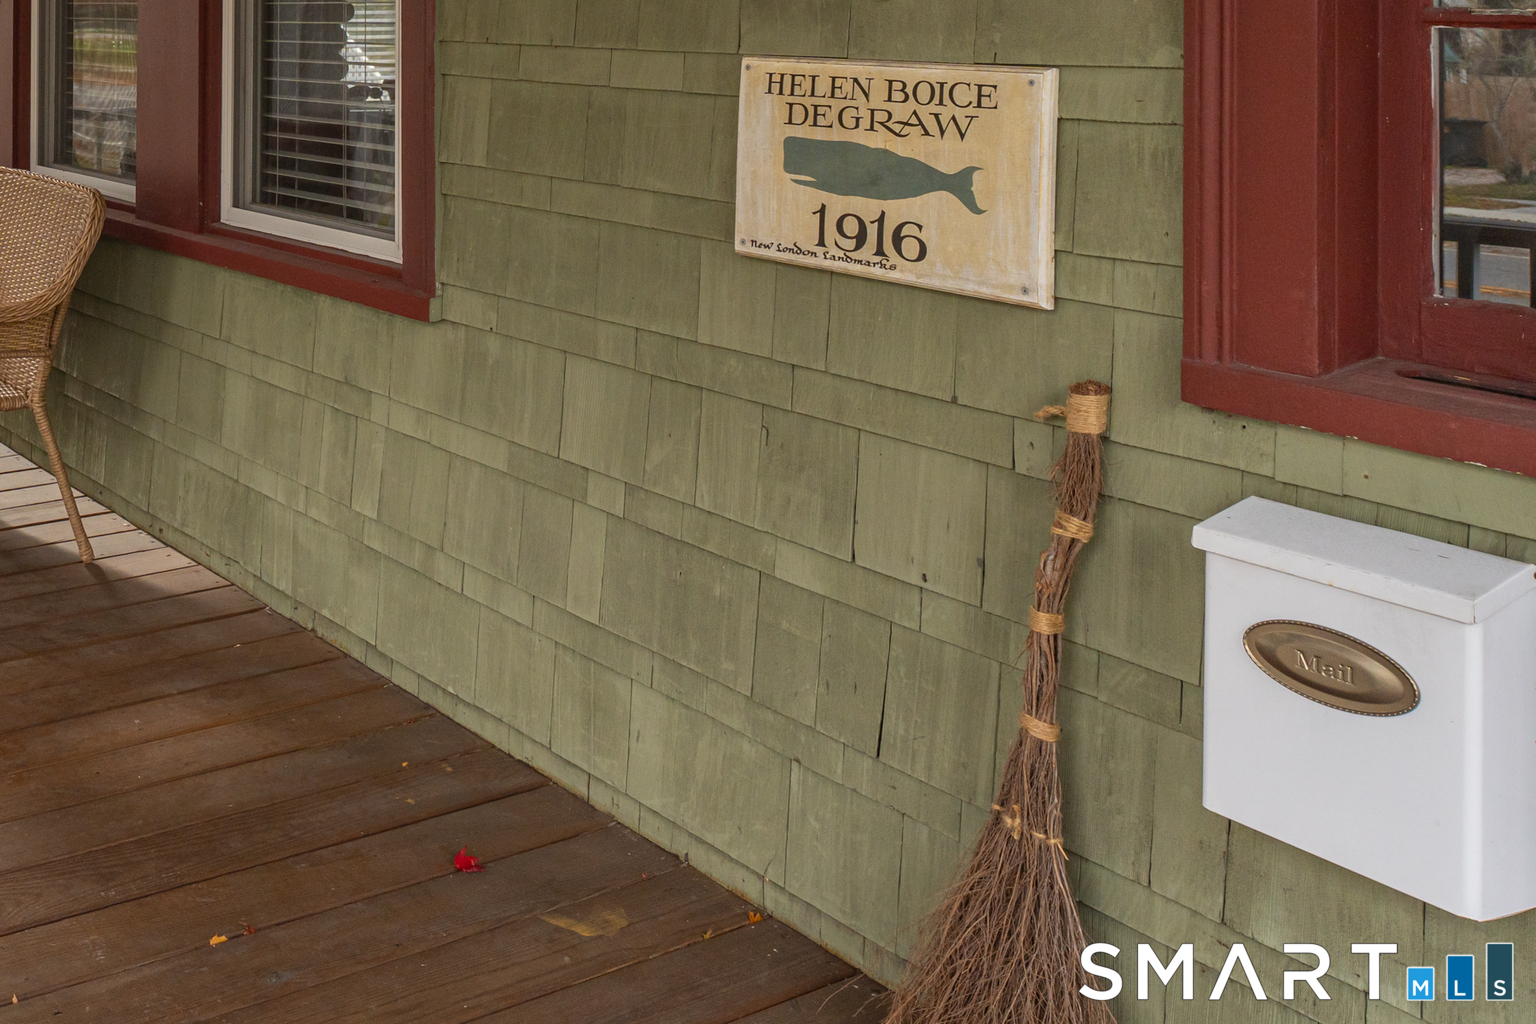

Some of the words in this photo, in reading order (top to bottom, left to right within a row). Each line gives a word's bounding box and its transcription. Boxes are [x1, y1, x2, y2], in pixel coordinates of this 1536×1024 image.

[764, 72, 874, 103] HELEN
[883, 78, 999, 109] BOICE
[783, 102, 980, 142] DEGRAW
[811, 202, 928, 263] 1916
[750, 239, 774, 250] New
[776, 241, 818, 258] London
[822, 250, 897, 271] Landmarks
[1294, 649, 1356, 685] Mail
